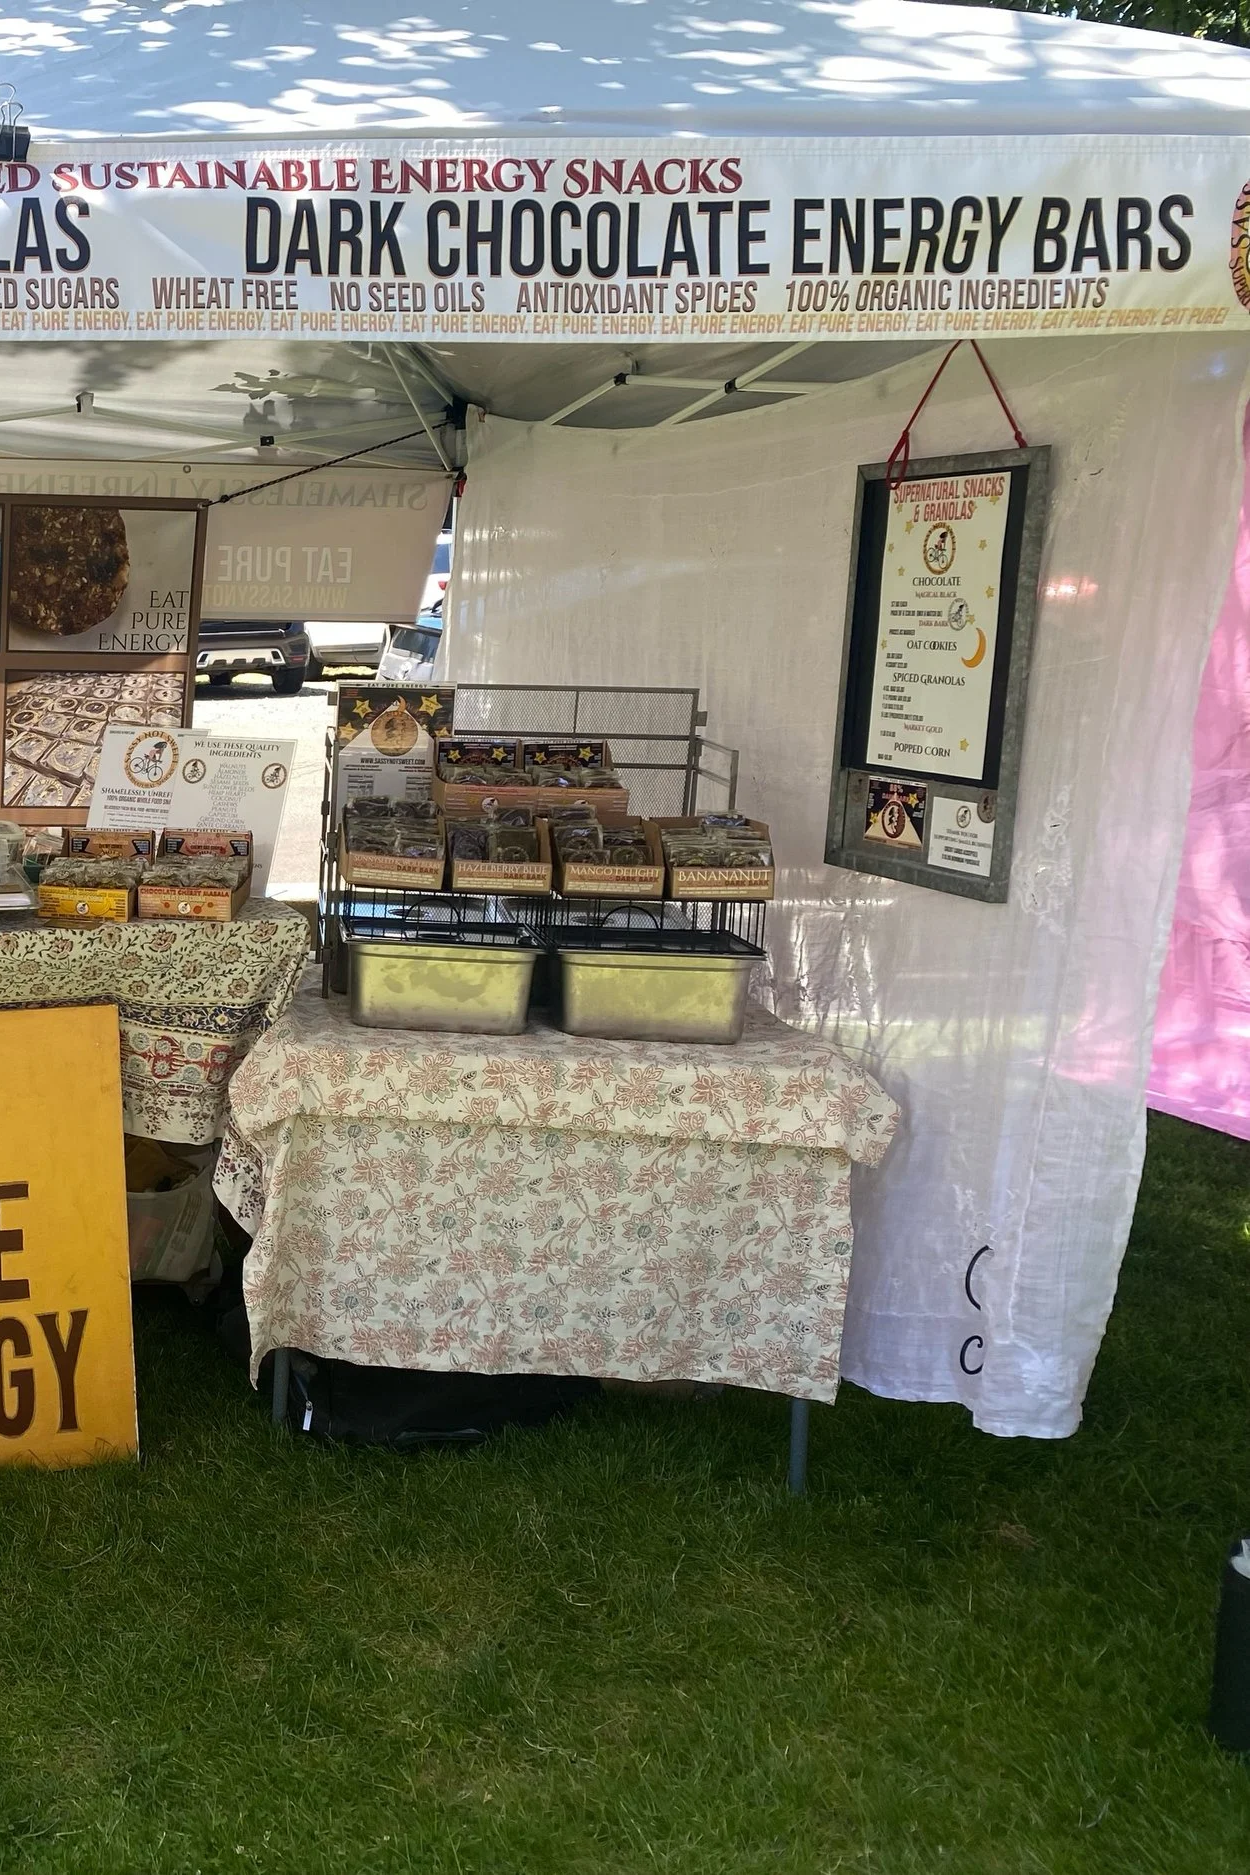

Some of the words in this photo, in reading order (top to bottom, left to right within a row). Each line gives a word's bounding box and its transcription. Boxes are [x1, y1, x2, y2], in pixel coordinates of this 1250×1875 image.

[52, 158, 361, 193] SUSTAINABLE
[370, 157, 556, 194] ENERGY
[565, 157, 742, 197] SNACKS
[245, 196, 406, 278] DARK
[426, 198, 770, 278] CHOCOLATE
[792, 195, 1023, 277] ENERGY
[1033, 194, 1194, 275] BARS
[25, 277, 119, 311] SUGARS
[152, 277, 238, 310] WHEAT
[242, 279, 298, 311] FREE
[330, 281, 362, 312] NO
[368, 281, 427, 313] SEED
[433, 281, 485, 313] OILS
[517, 282, 668, 314] ANTIOXIDANT
[675, 281, 757, 314] SPICES
[785, 281, 849, 313] 100%
[855, 280, 952, 313] ORGANIC
[958, 277, 1109, 311] INGREDIENTS
[894, 480, 960, 504] SUPERNATURAL
[963, 477, 1005, 498] SNACKS
[914, 505, 920, 522] &
[924, 500, 974, 522] GRANOLAS
[912, 577, 961, 586] CHOCOLATE
[150, 590, 189, 609] EAT
[131, 611, 187, 630] PURE
[98, 631, 185, 652] ENERGY
[907, 640, 922, 649] OAT
[924, 641, 957, 651] COOKIES
[893, 673, 919, 682] SPICED
[921, 674, 965, 686] GRANOLAS
[209, 750, 262, 758] INGREDIENTS
[894, 742, 922, 754] POPPED
[925, 746, 950, 757] CORN
[459, 864, 520, 873] HAZELBERRY
[523, 865, 547, 874] BLUE
[571, 867, 613, 875] MANGO
[614, 867, 659, 877] DELIGHT
[678, 869, 771, 881] BANANANUT
